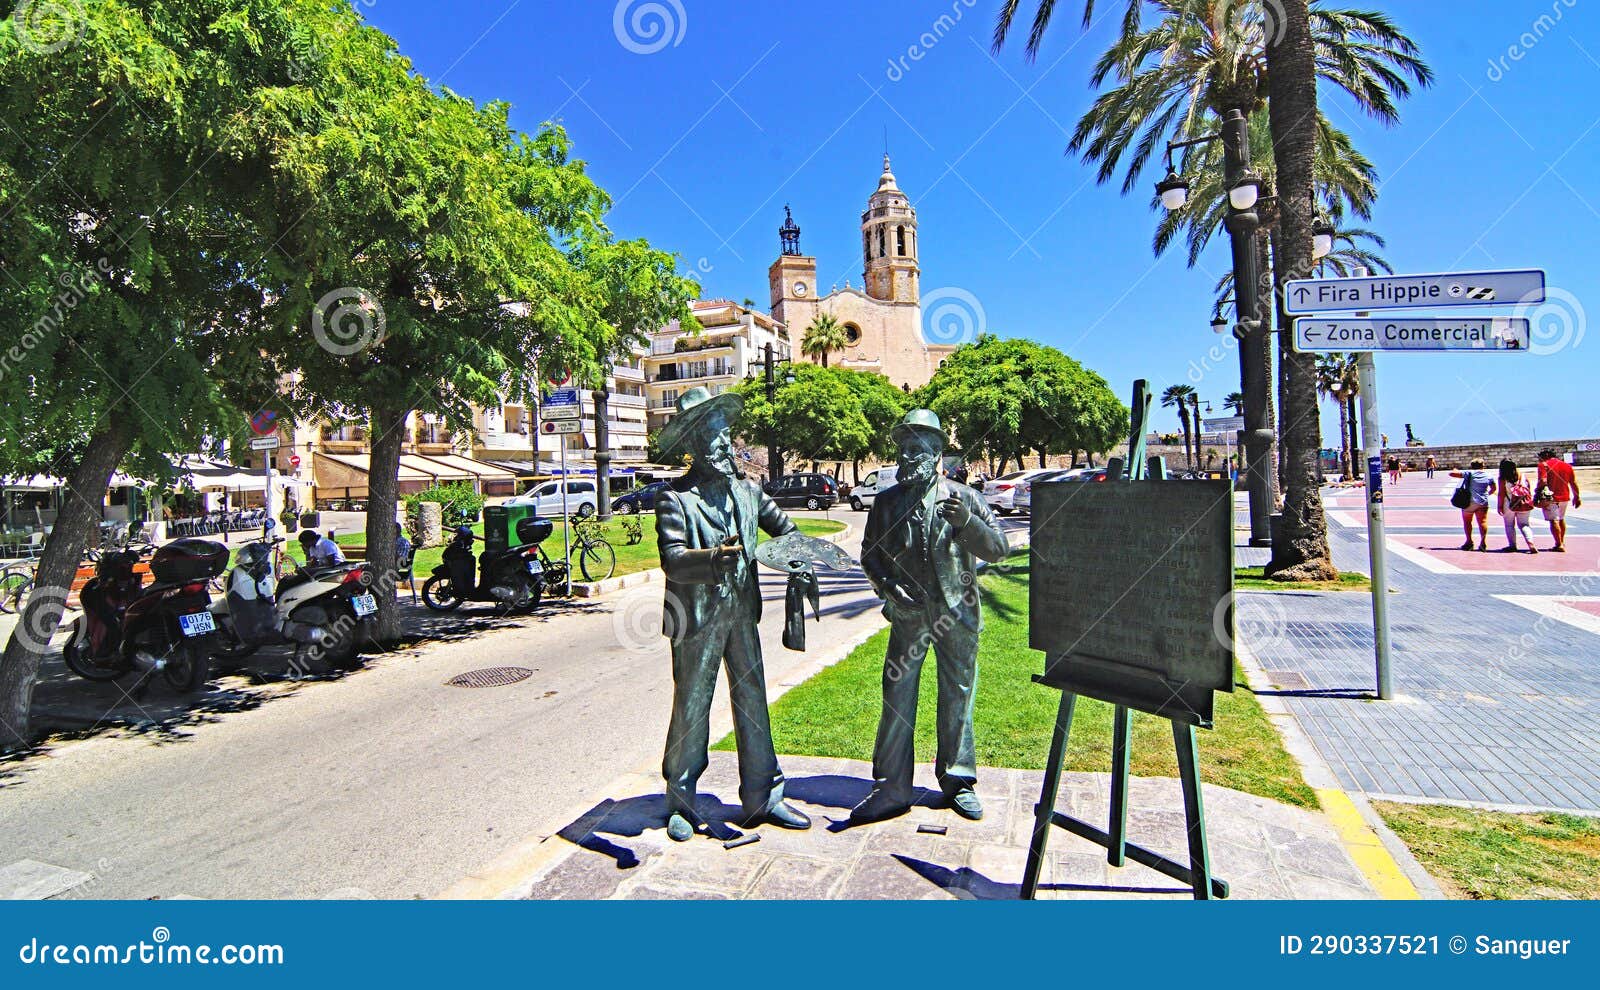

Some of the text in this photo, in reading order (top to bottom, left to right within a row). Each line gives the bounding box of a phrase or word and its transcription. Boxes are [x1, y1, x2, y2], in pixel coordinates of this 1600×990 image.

[1318, 281, 1440, 303] Fira Hippie
[1327, 324, 1486, 341] Zona Comercial
[188, 613, 211, 624] 0176
[193, 621, 212, 632] HSN
